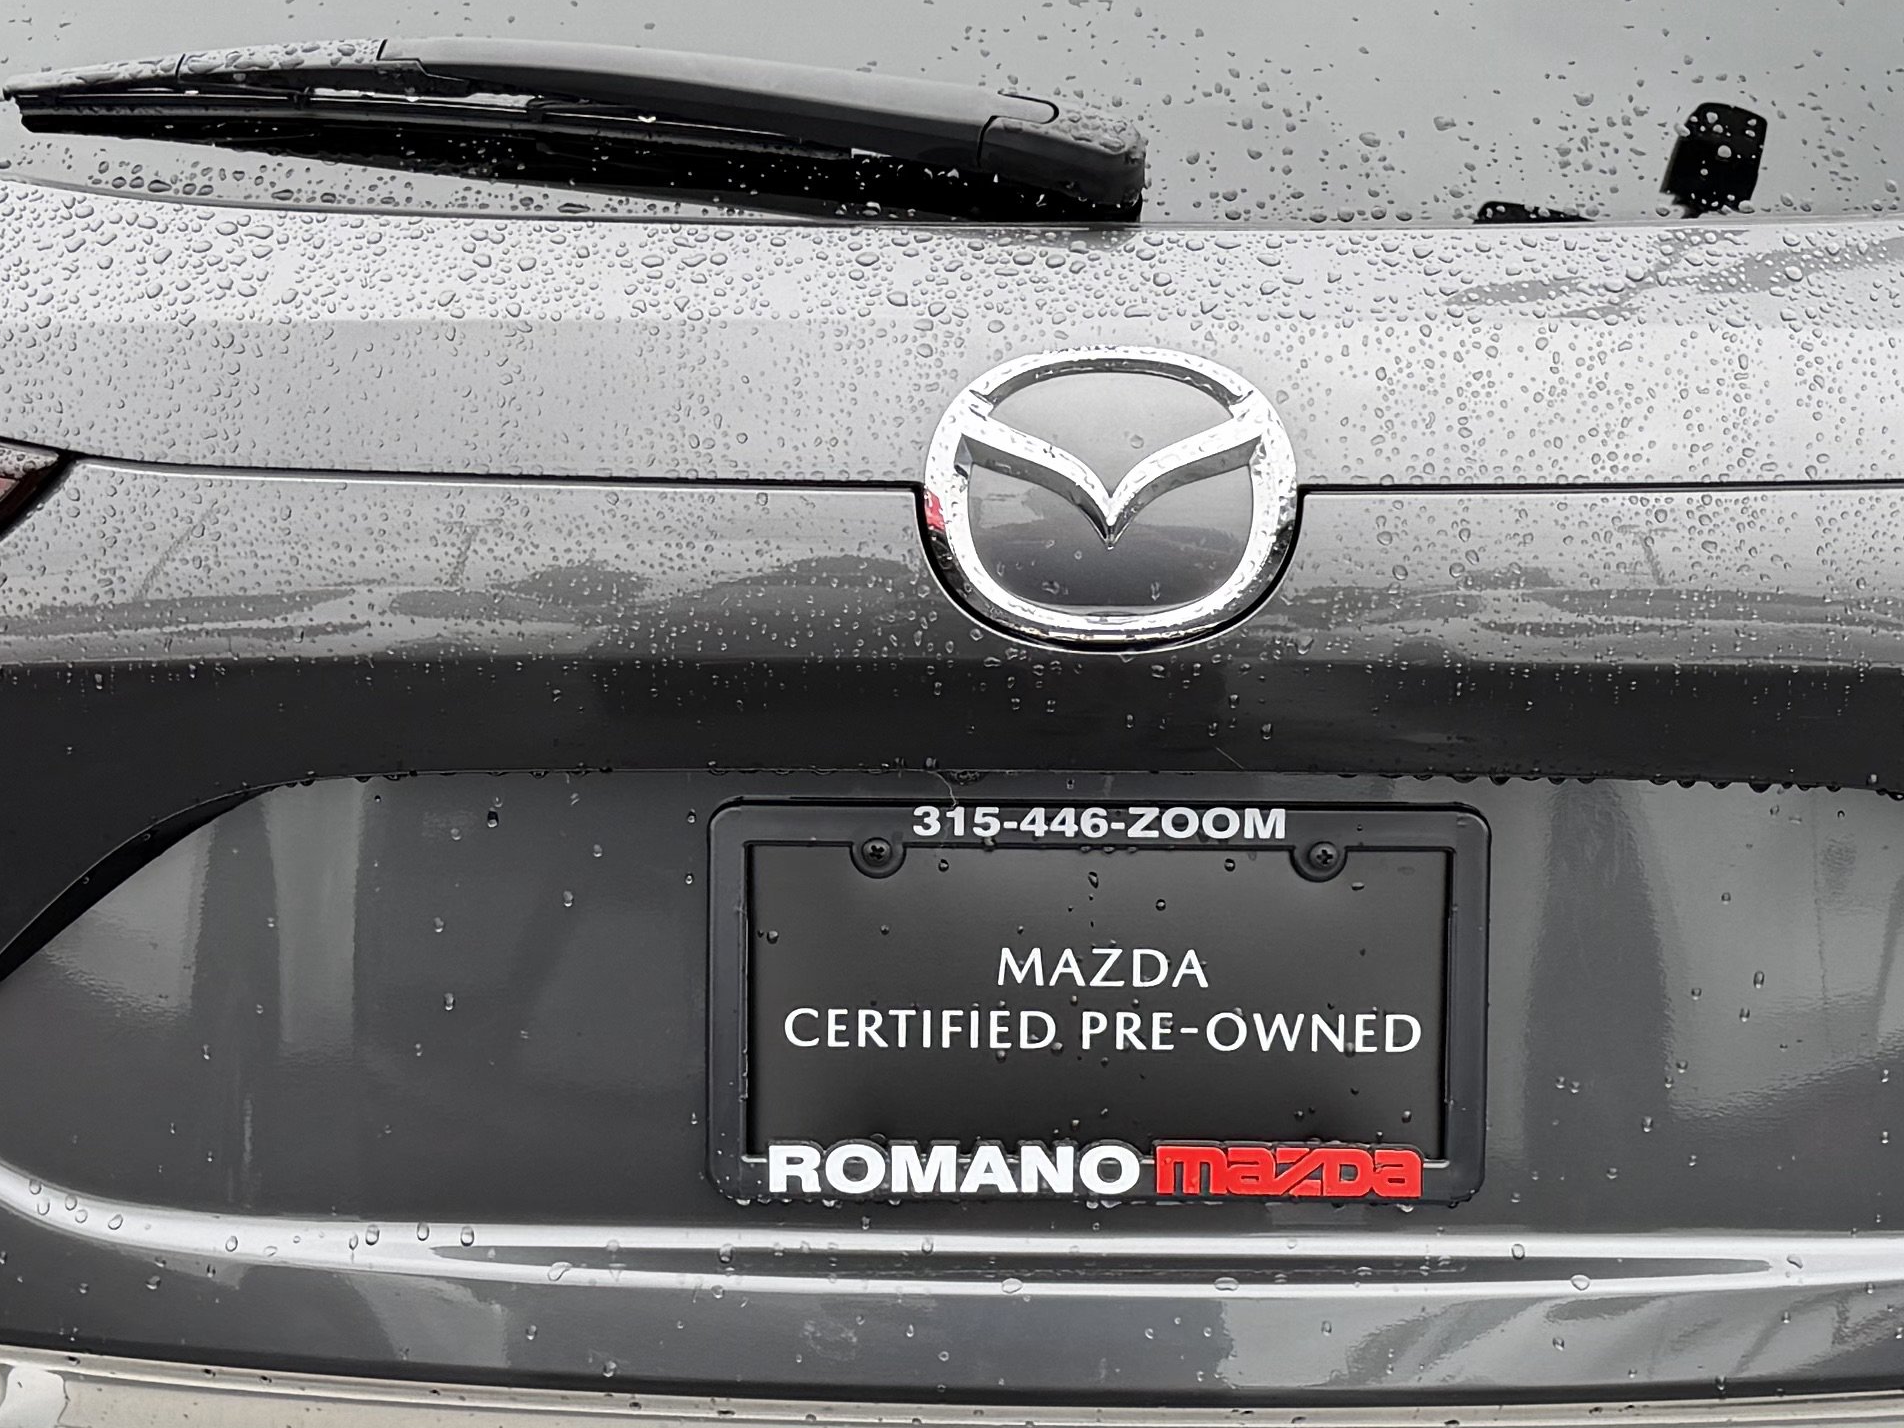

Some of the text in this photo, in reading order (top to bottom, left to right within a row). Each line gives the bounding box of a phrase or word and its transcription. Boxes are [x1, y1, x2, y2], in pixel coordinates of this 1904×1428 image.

[911, 805, 1288, 841] 315-446-ZOOM
[996, 946, 1209, 990] MAZDA
[783, 1006, 1423, 1054] CERTIFIED PRE-OWNED
[768, 1143, 1140, 1196] ROMANO
